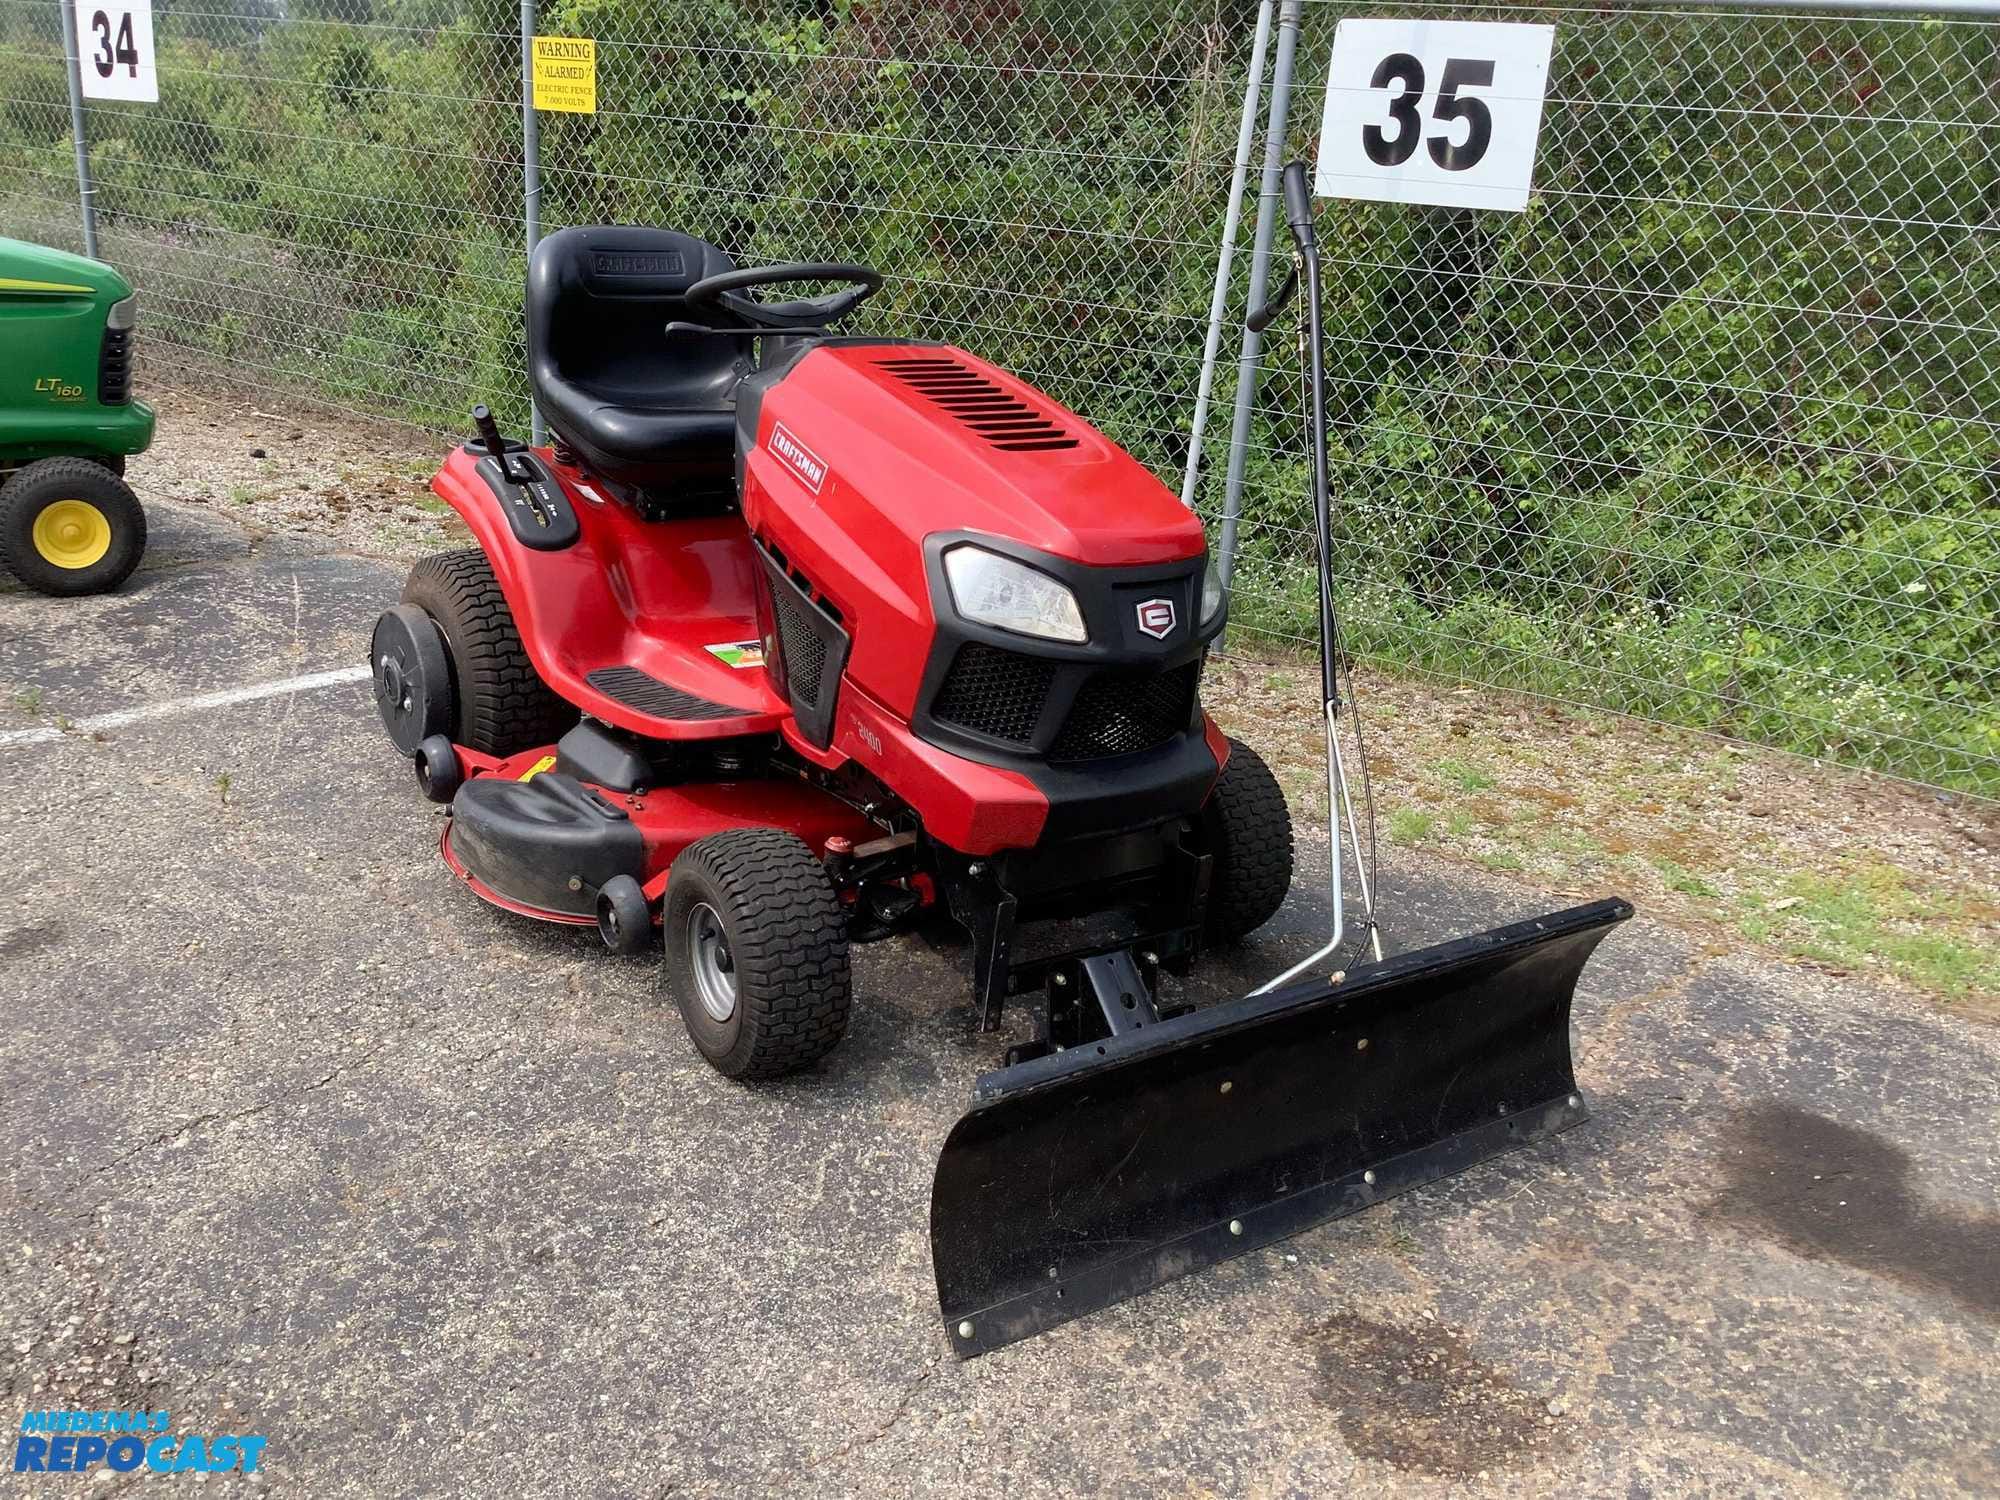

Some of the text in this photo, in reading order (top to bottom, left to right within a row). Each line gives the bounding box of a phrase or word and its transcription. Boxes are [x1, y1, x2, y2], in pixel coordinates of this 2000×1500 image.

[92, 10, 138, 78] 34
[537, 41, 591, 59] WARNING
[544, 65, 585, 80] ALARMED
[536, 83, 593, 95] ELECTRIC FENCE
[563, 97, 586, 107] VOLTS
[1362, 52, 1496, 171] 35
[35, 378, 82, 396] LT 160
[773, 431, 822, 484] CRAFTSMAN
